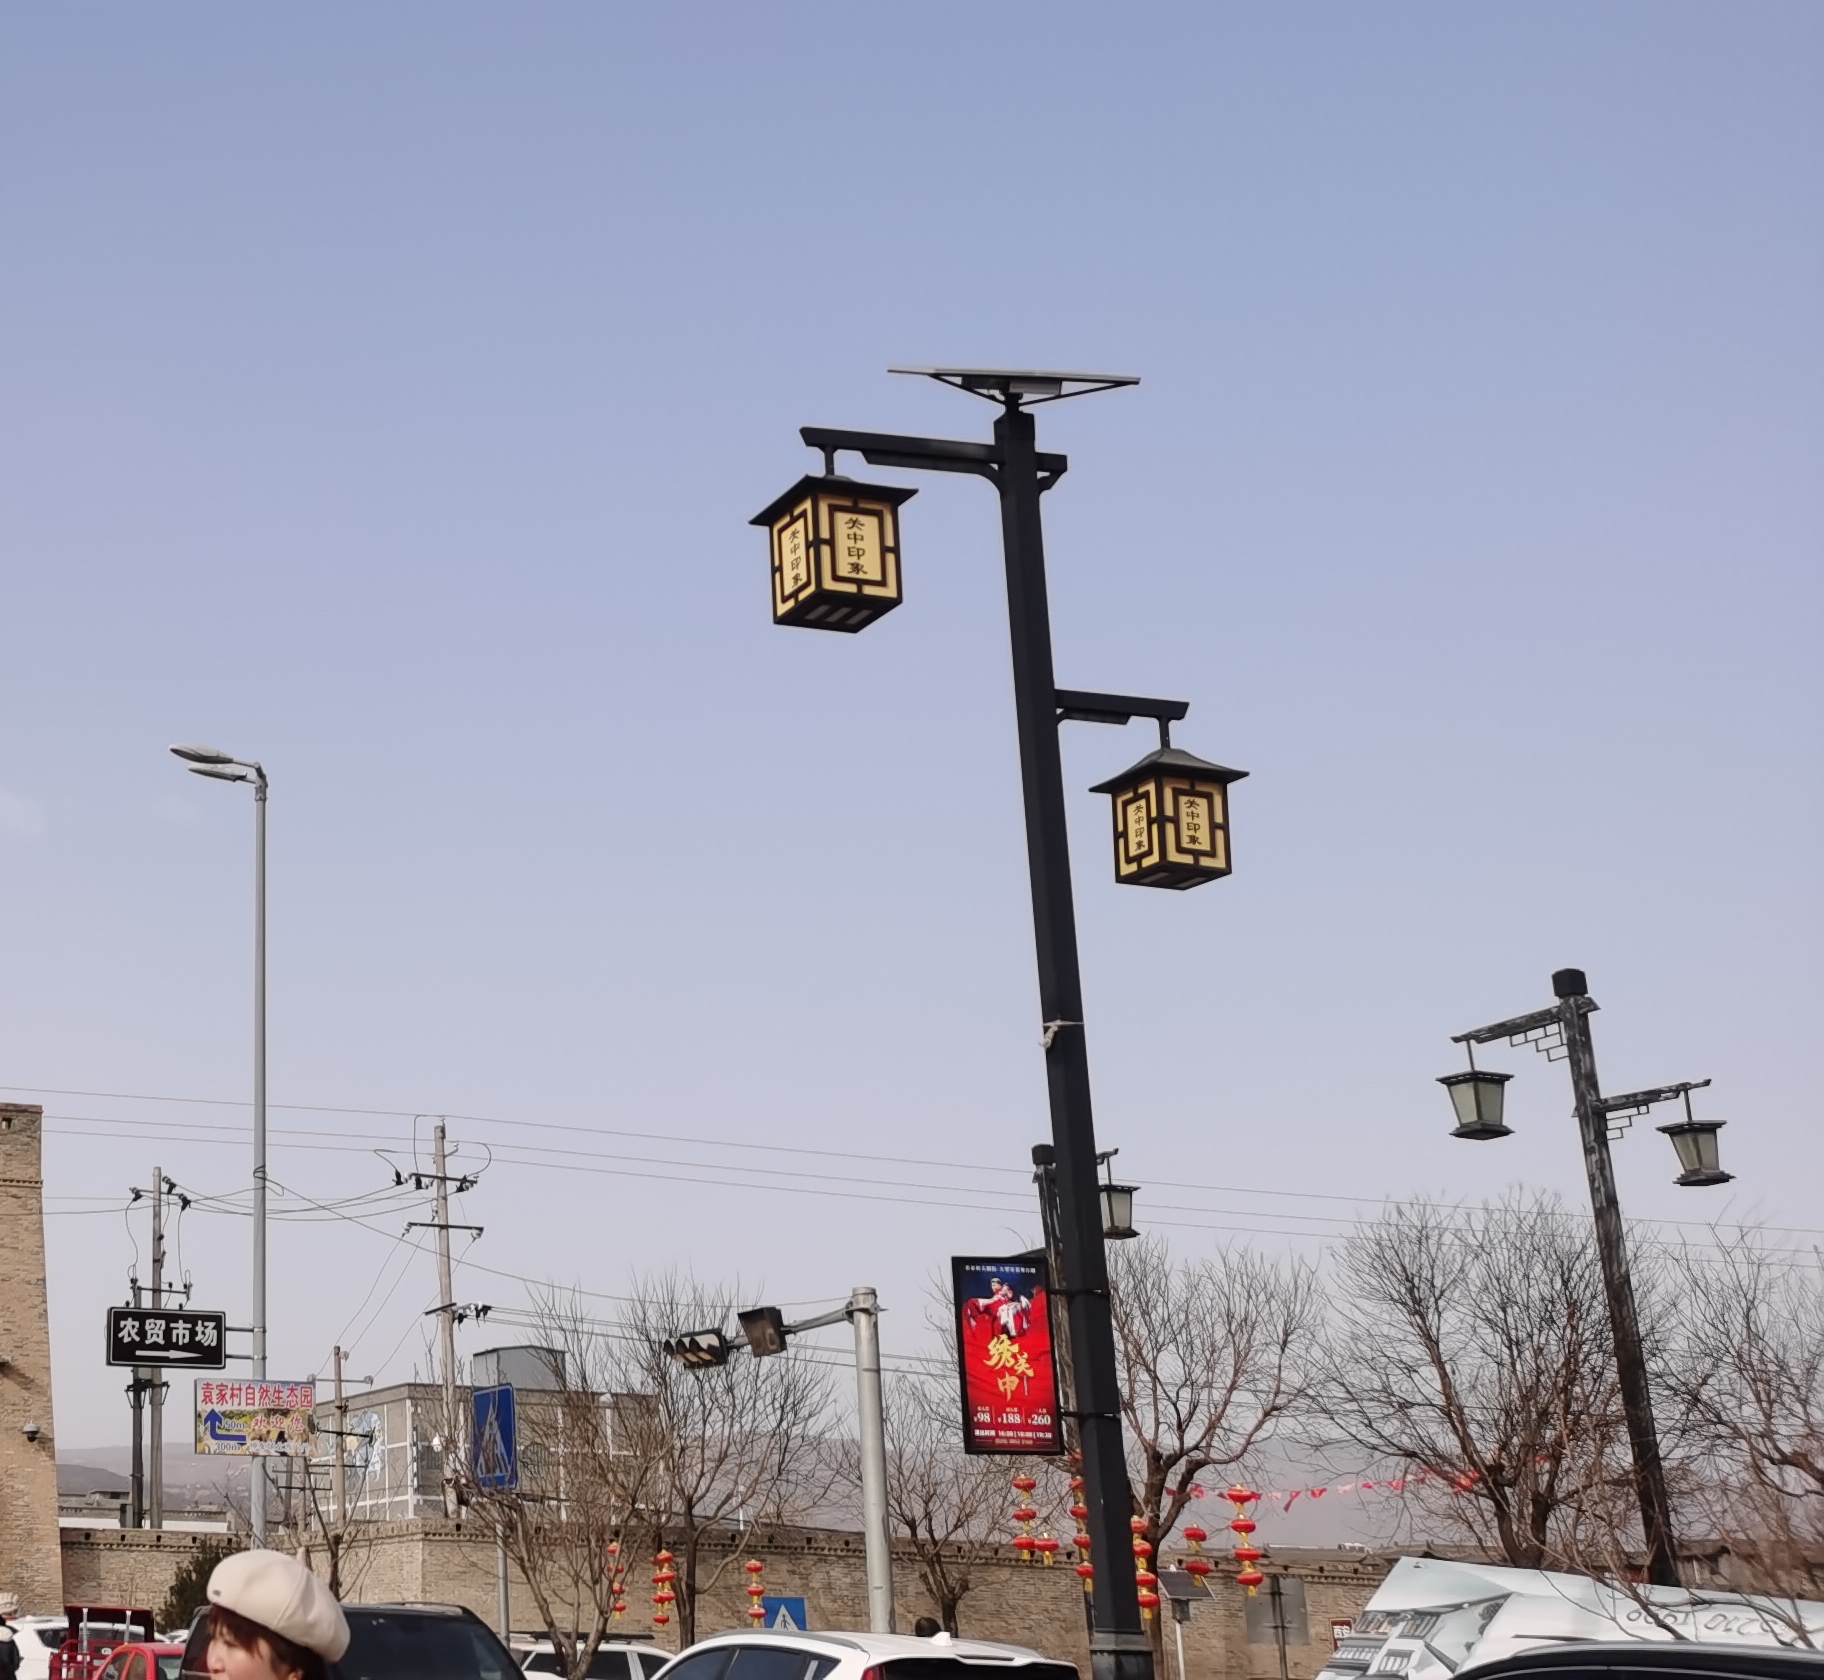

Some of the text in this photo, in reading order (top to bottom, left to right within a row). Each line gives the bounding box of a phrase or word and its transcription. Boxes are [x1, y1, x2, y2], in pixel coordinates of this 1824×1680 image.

[788, 527, 803, 589] 关中印象
[844, 516, 868, 576] 关中印象
[1133, 803, 1146, 852] 关中印象
[1184, 798, 1202, 846] 关中印象
[117, 1317, 218, 1347] 农贸市场
[201, 1382, 314, 1409] 袁家村自然生态园
